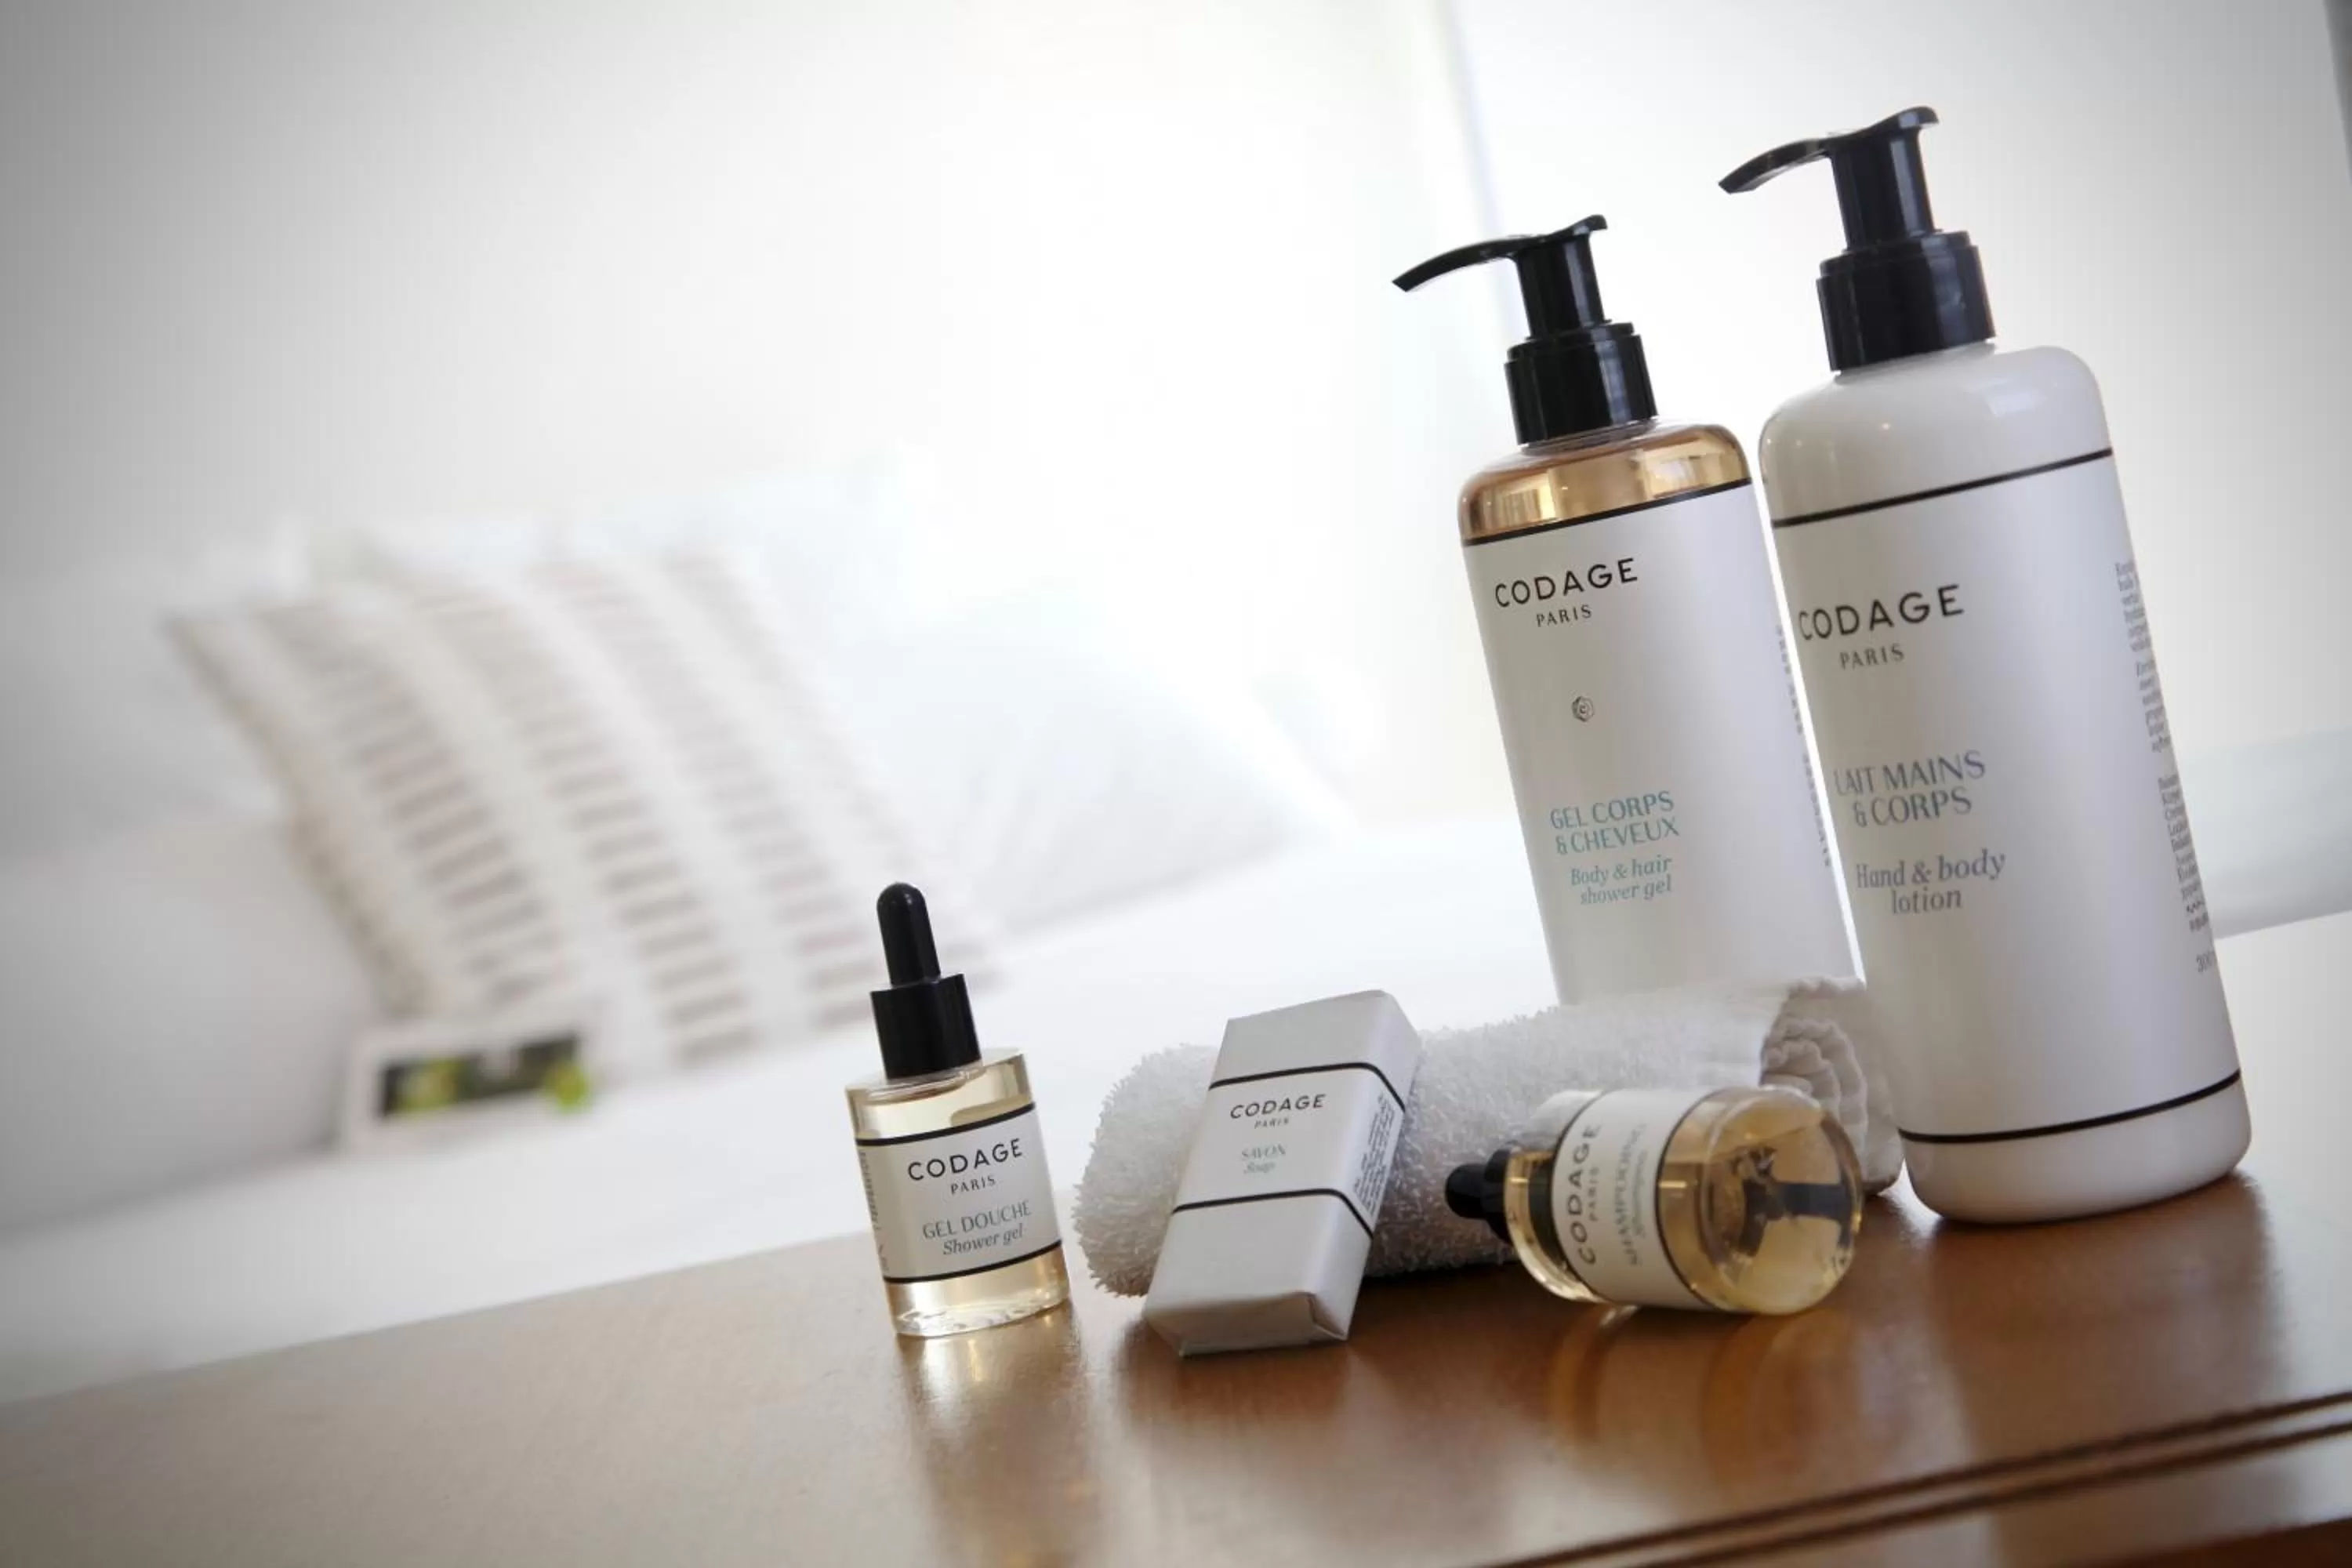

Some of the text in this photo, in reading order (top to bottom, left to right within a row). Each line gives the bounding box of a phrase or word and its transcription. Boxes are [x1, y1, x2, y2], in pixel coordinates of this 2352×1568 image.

[1495, 557, 1638, 608] CODAGE
[1536, 604, 1592, 627] PARIS
[1798, 584, 1964, 641] CODAGE
[1839, 642, 1904, 670] PARIS
[1833, 749, 1986, 797] LAIT MAINS
[1550, 790, 1675, 829] GEL CORPS
[1871, 786, 1973, 826] CORPS
[1570, 816, 1679, 853] CHEVEUX
[1571, 854, 1672, 887] Body & hair
[1856, 847, 2006, 888] Hand & body
[1581, 873, 1672, 905] shower gel
[1891, 885, 1962, 914] lotion
[1229, 1094, 1327, 1119] CODAGE
[908, 1138, 1023, 1181] CODAGE
[950, 1174, 996, 1196] PARIS
[1567, 1123, 1601, 1265] CODAGE
[922, 1200, 1033, 1240] GEL DOUCHE
[942, 1222, 1023, 1255] Shower gel
